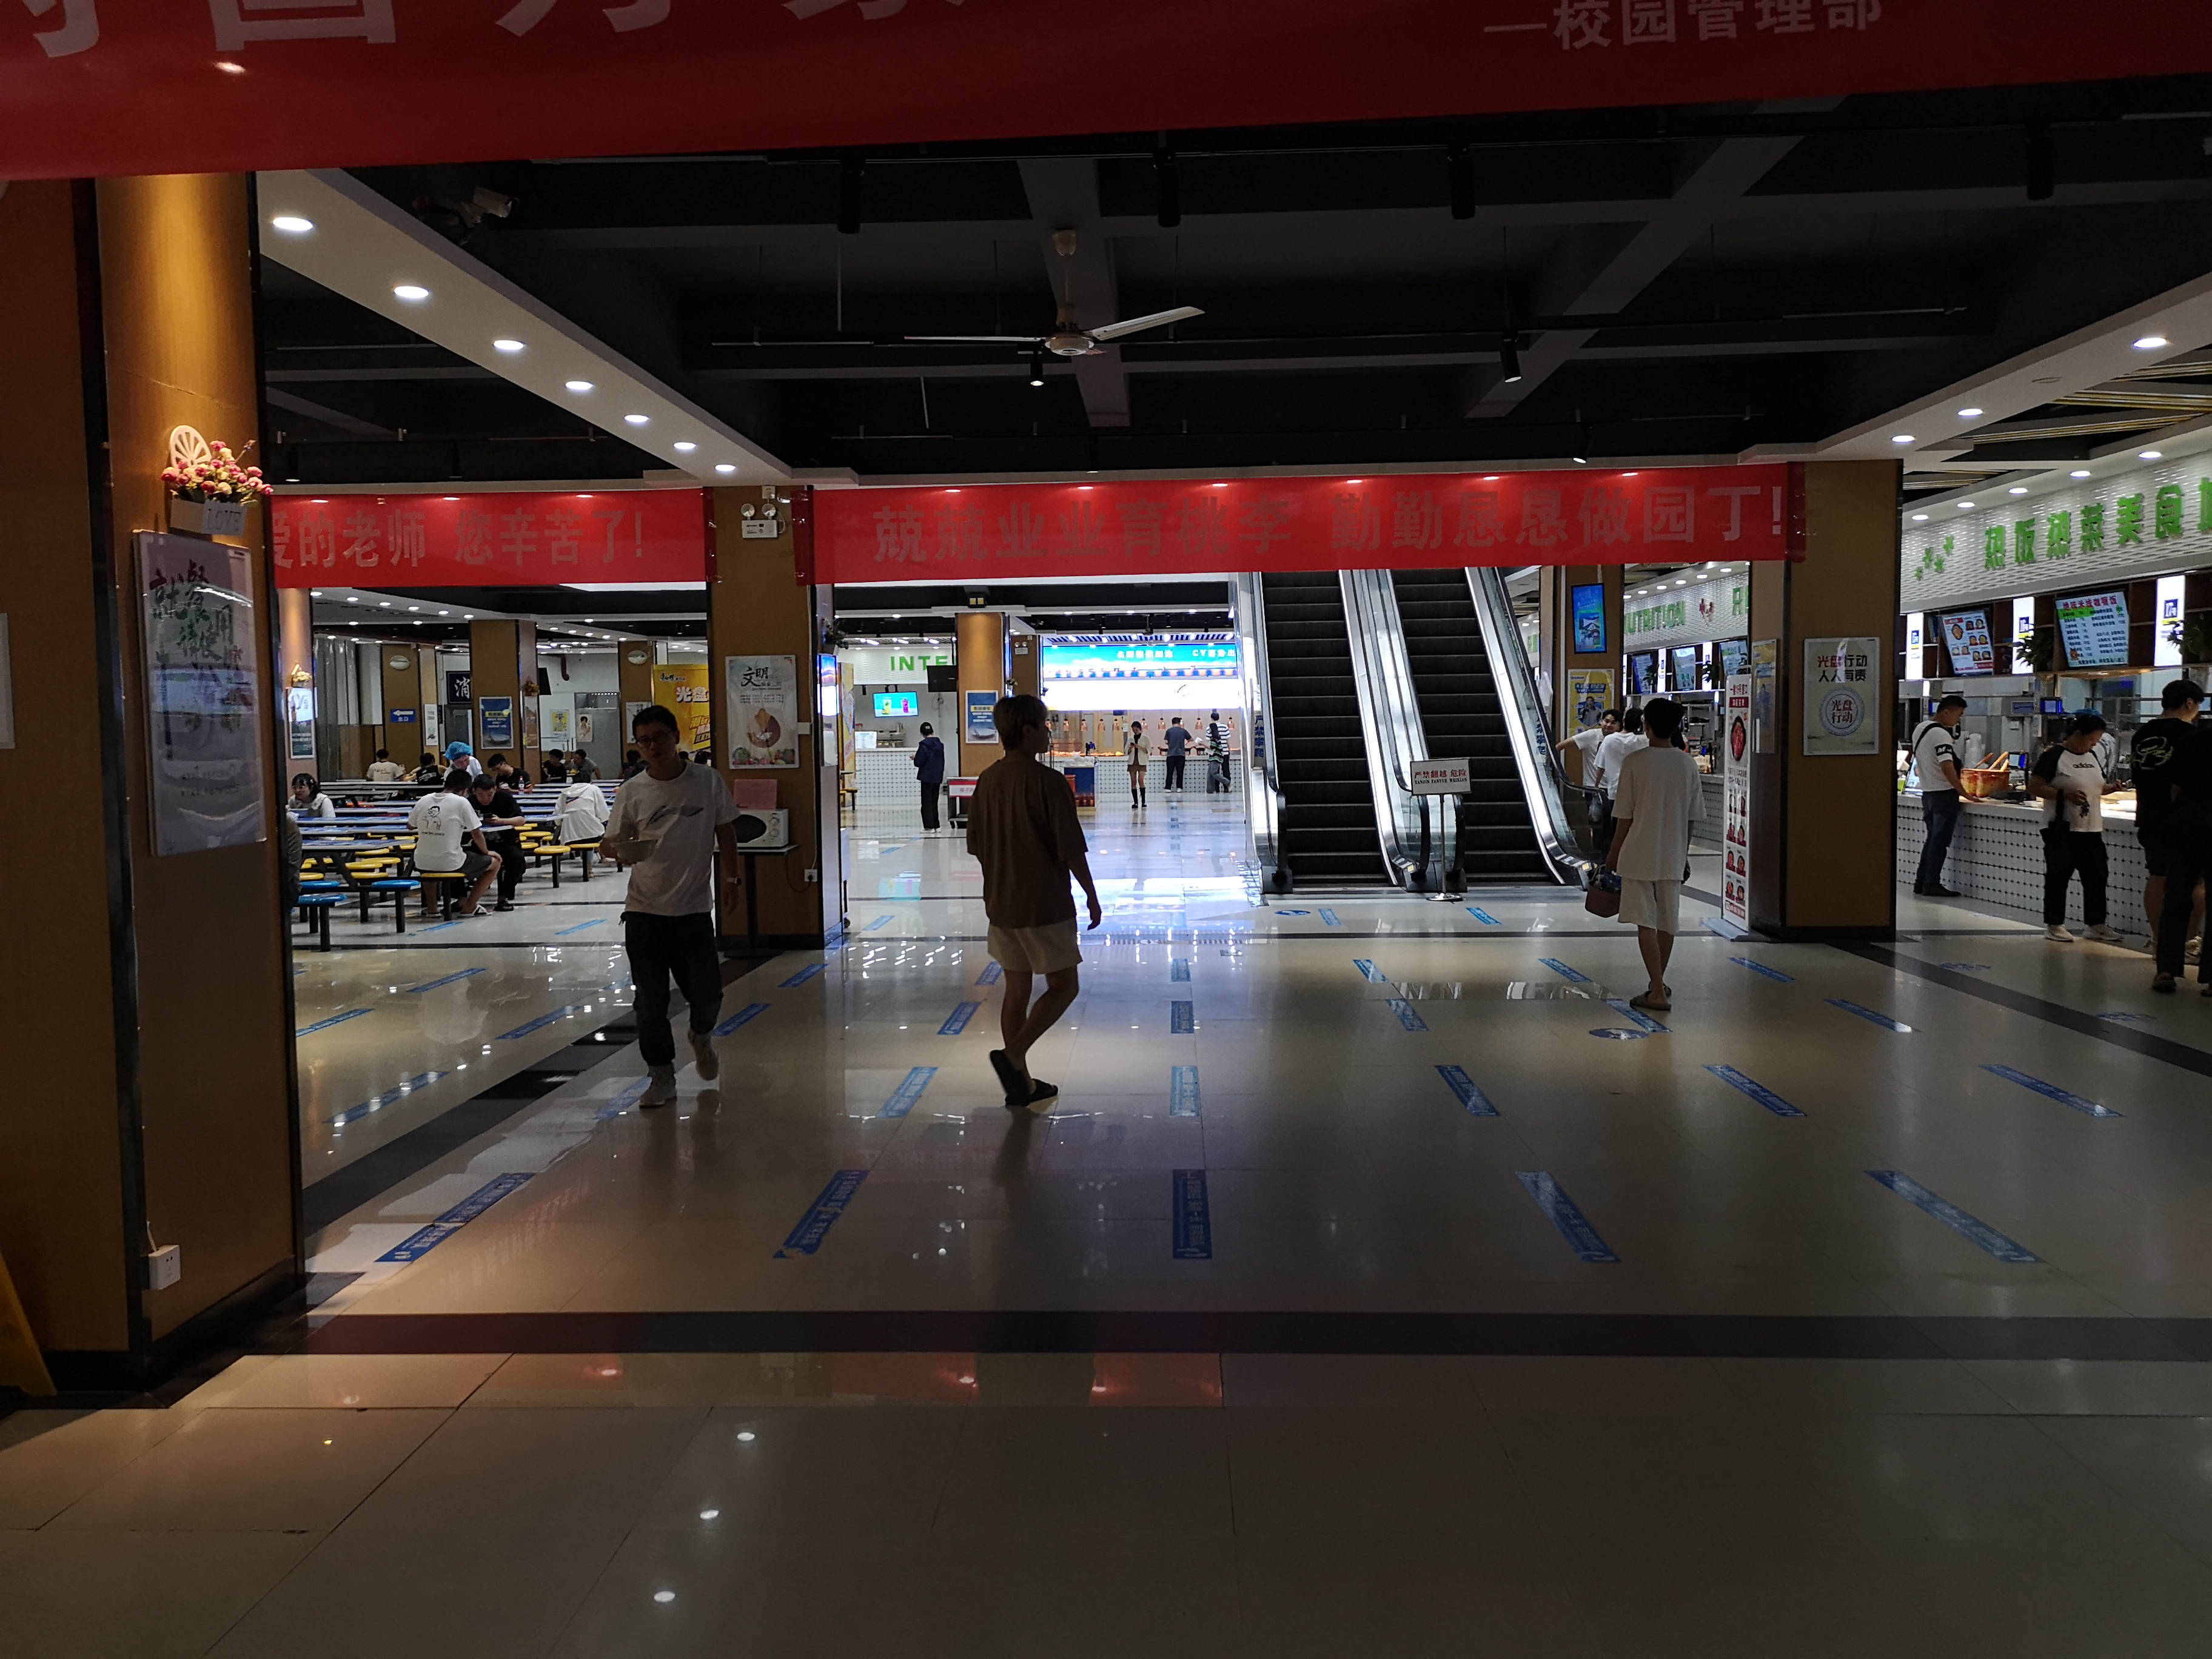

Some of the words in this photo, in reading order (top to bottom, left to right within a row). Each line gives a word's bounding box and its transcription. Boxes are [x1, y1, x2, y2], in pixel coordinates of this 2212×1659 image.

[873, 495, 1291, 563] 兢兢业业育桃李
[1818, 655, 1867, 668] 光盘行动
[741, 666, 768, 686] 文明
[675, 686, 708, 703] 光盘
[1832, 700, 1852, 711] 光盘
[1832, 711, 1852, 723] 行动
[1451, 768, 1467, 777] 危险
